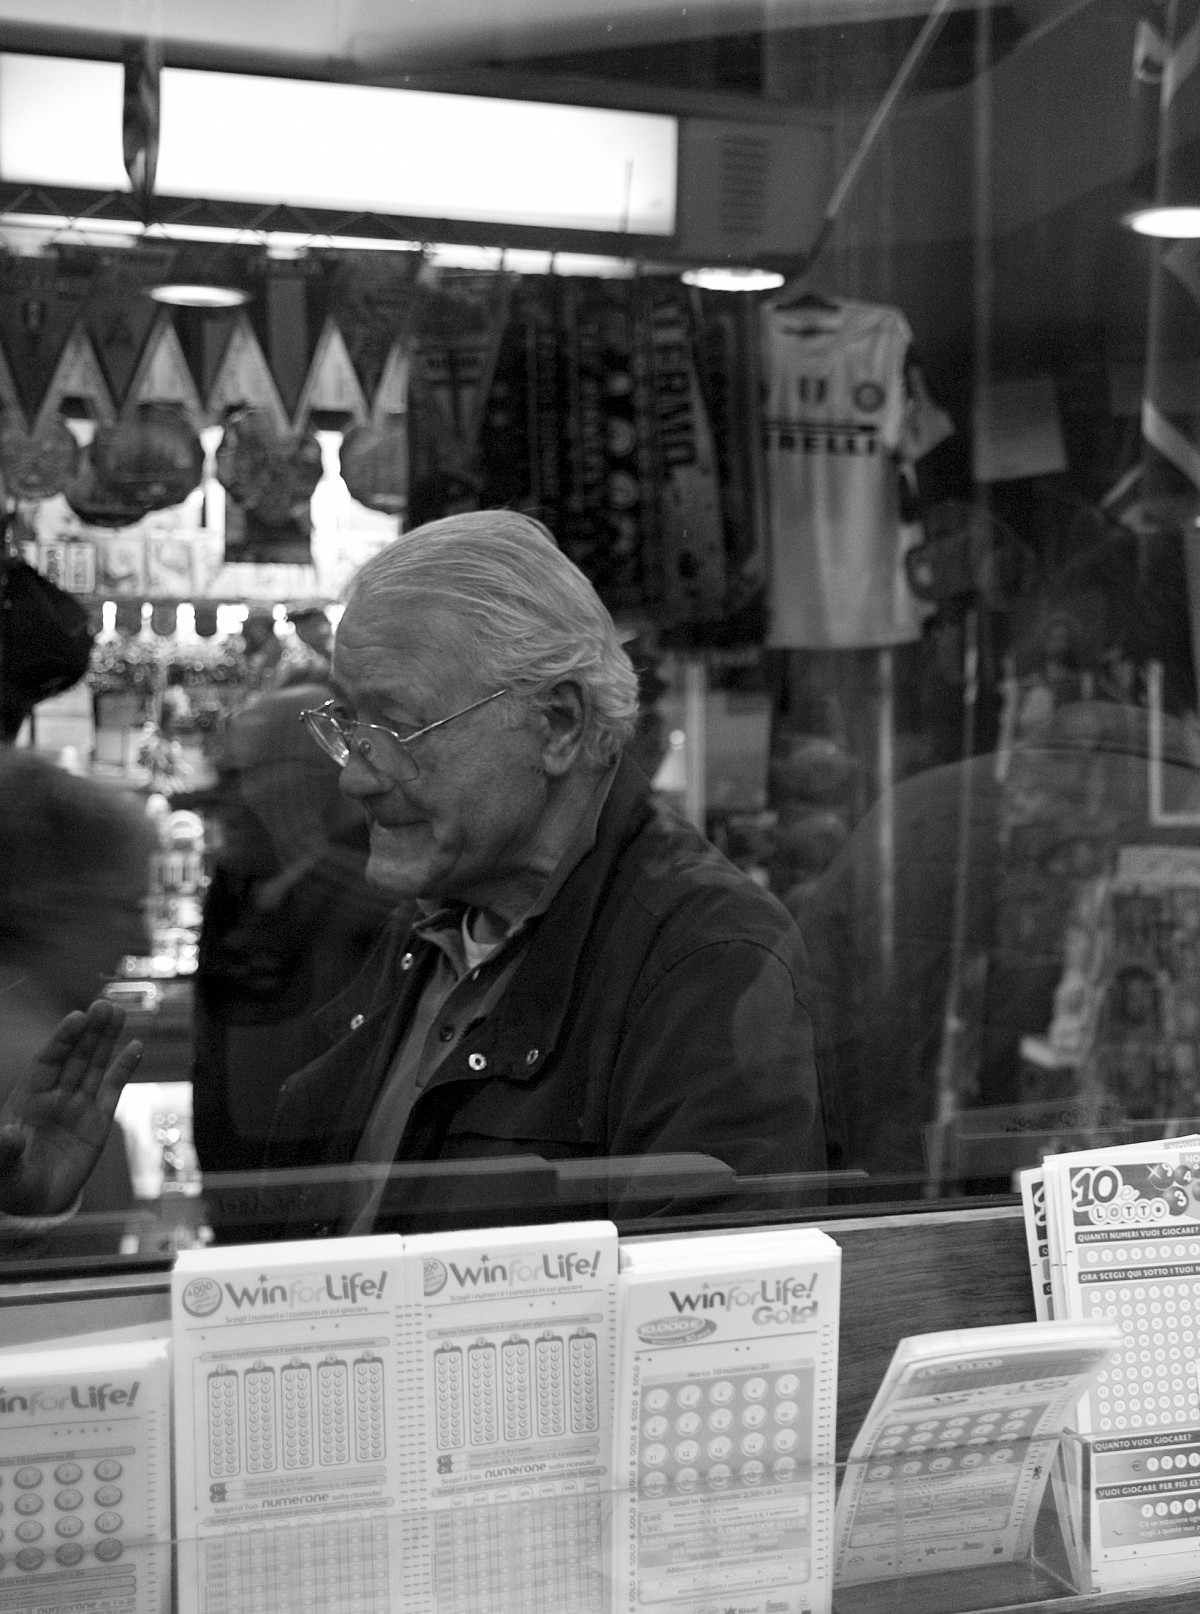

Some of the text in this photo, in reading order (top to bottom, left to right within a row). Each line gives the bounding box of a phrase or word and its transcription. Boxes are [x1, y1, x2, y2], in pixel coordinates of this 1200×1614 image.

[1077, 1226, 1199, 1242] QUANTI NUMERI VUOI GIOCARE?
[1081, 1272, 1098, 1281] ORA
[1099, 1271, 1126, 1280] SCEGLI
[1127, 1269, 1142, 1278] QUI
[1143, 1267, 1168, 1277] SOTTO
[1175, 1265, 1194, 1274] TUOI
[752, 1301, 818, 1325] Gold
[1095, 1433, 1192, 1451] QUANTO VUOI GIOCARE?
[484, 1462, 547, 1479] numerone
[1099, 1487, 1120, 1497] VUOI
[1122, 1483, 1157, 1494] GIOCARE
[1158, 1481, 1173, 1490] PER
[261, 1492, 330, 1509] numerone
